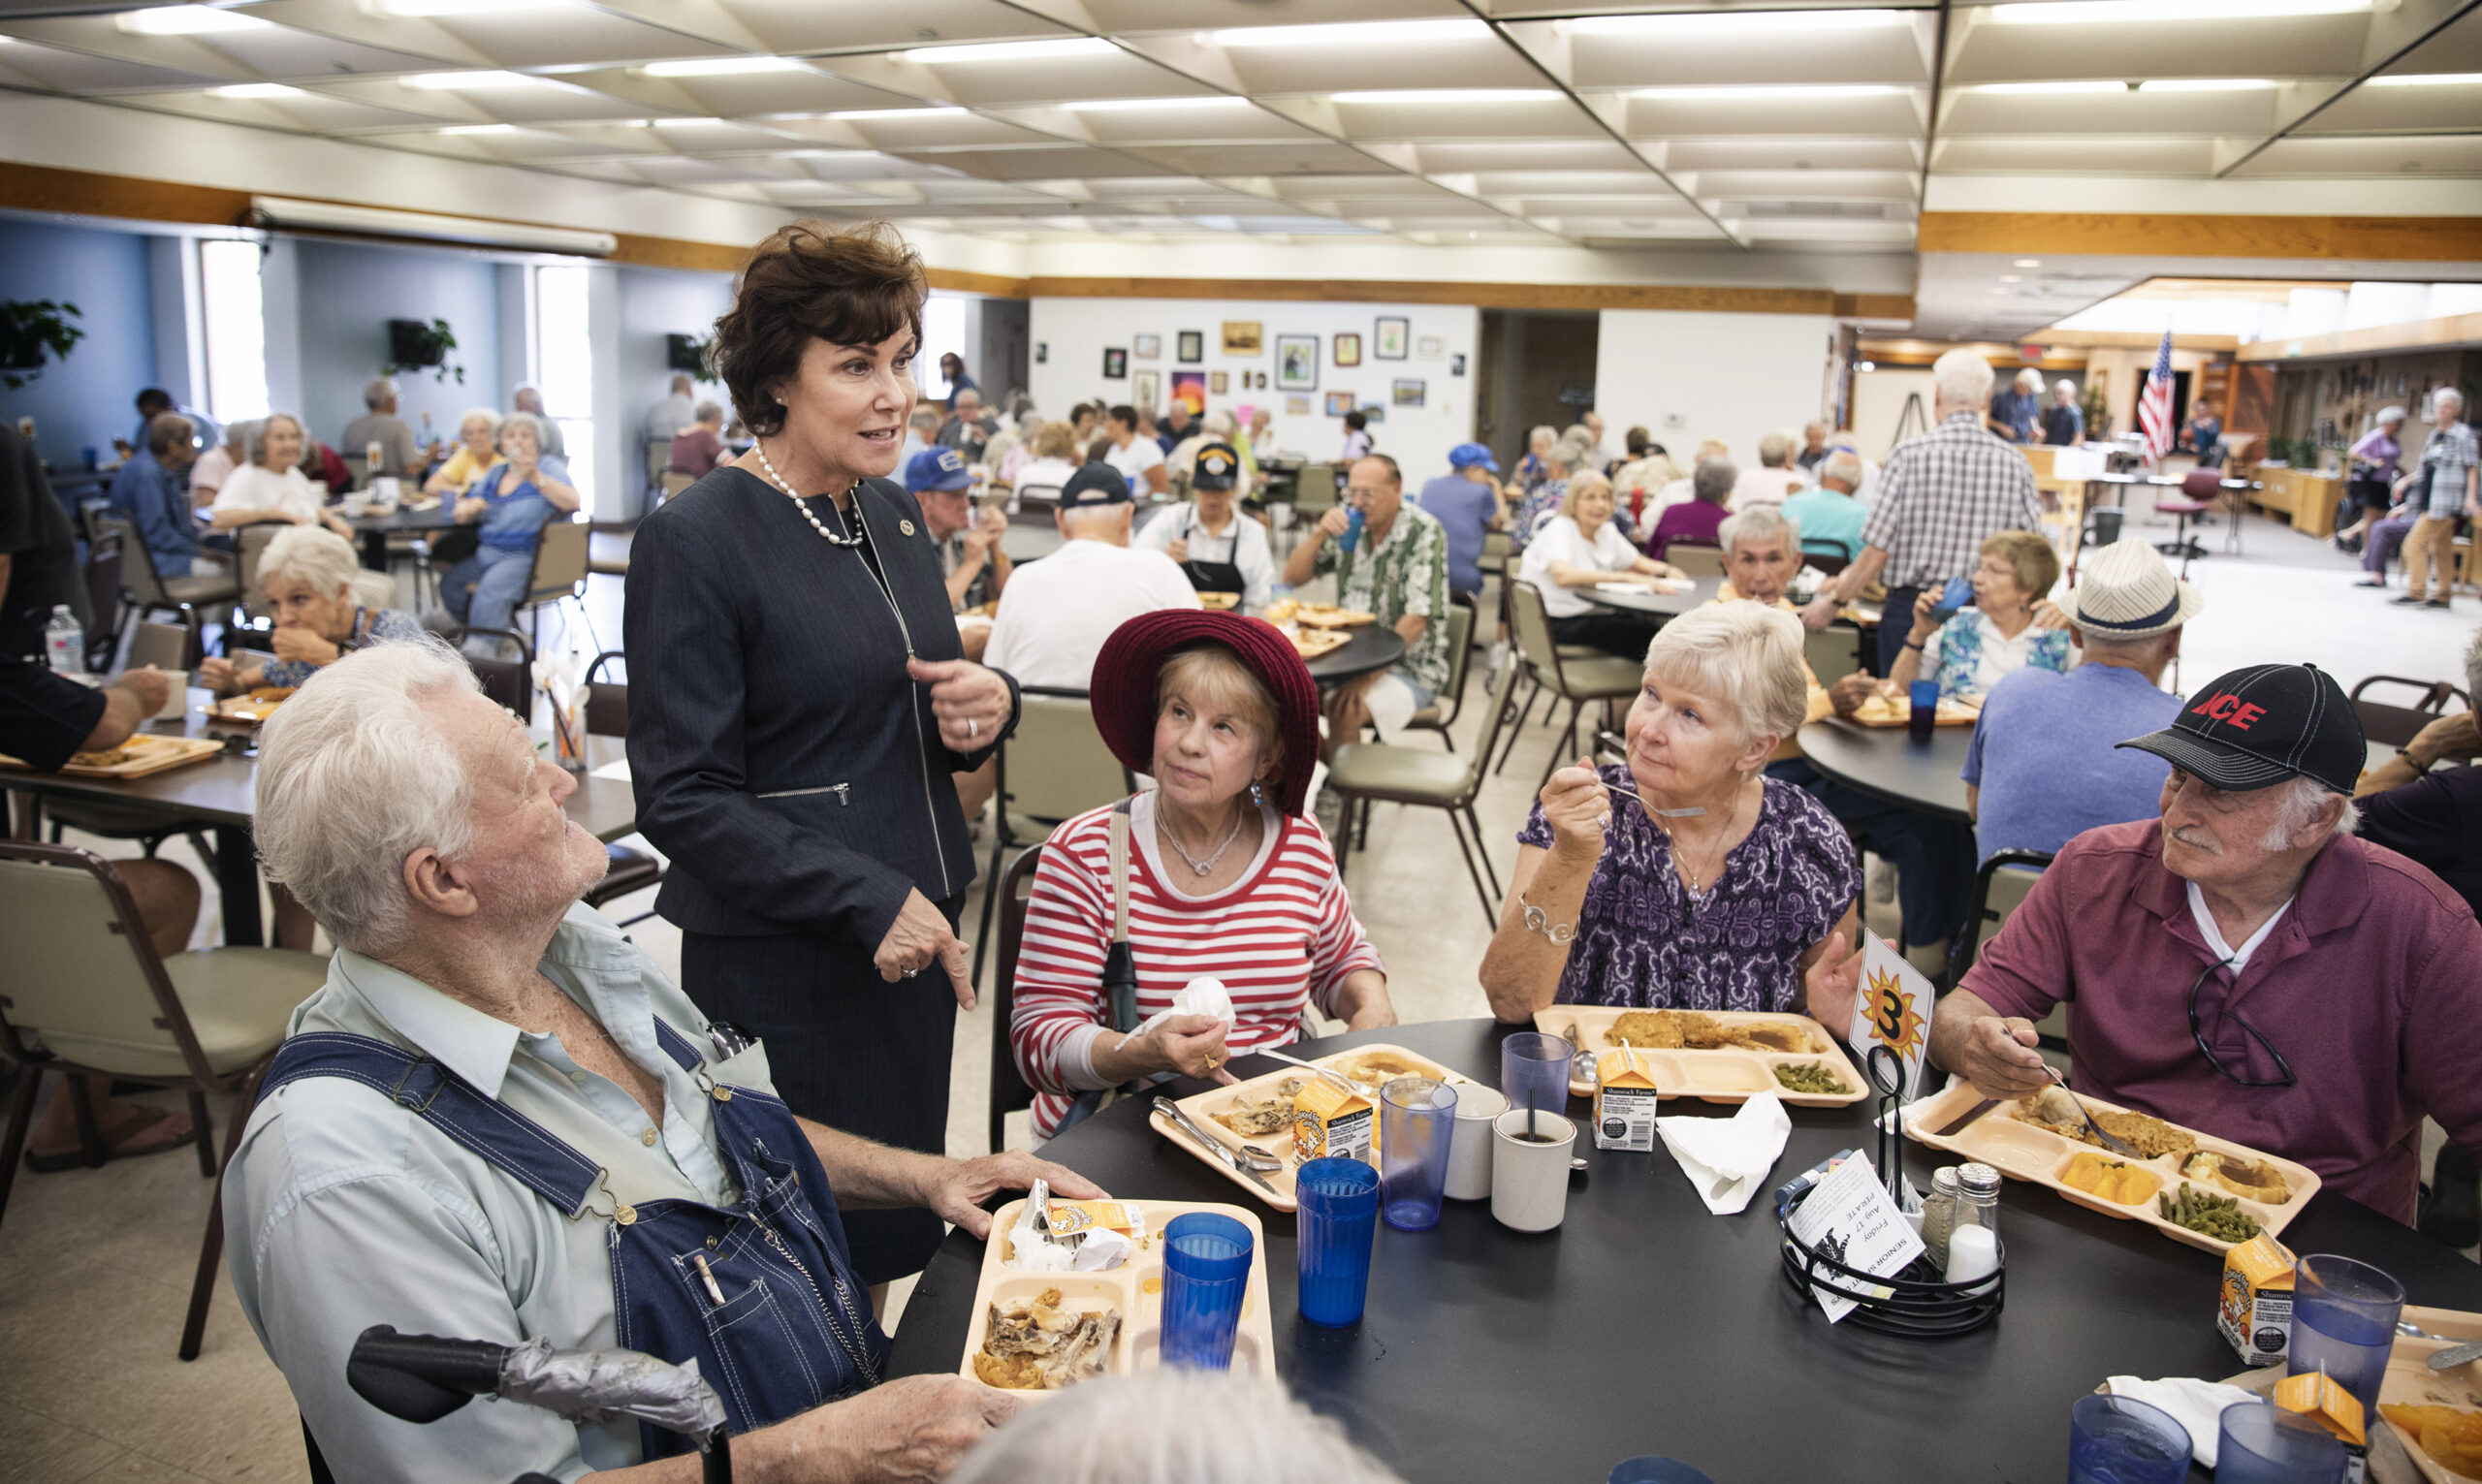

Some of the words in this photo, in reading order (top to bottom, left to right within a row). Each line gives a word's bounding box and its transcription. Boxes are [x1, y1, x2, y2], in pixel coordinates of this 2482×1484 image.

[2191, 688, 2268, 731] ACE
[1877, 989, 1902, 1040] 3
[1331, 1114, 1354, 1126] Shamrock
[1846, 1192, 1875, 1221] PIRATE
[1855, 1220, 1864, 1233] 17
[1863, 1218, 1889, 1242] Friday
[1877, 1238, 1907, 1267] SENIOR
